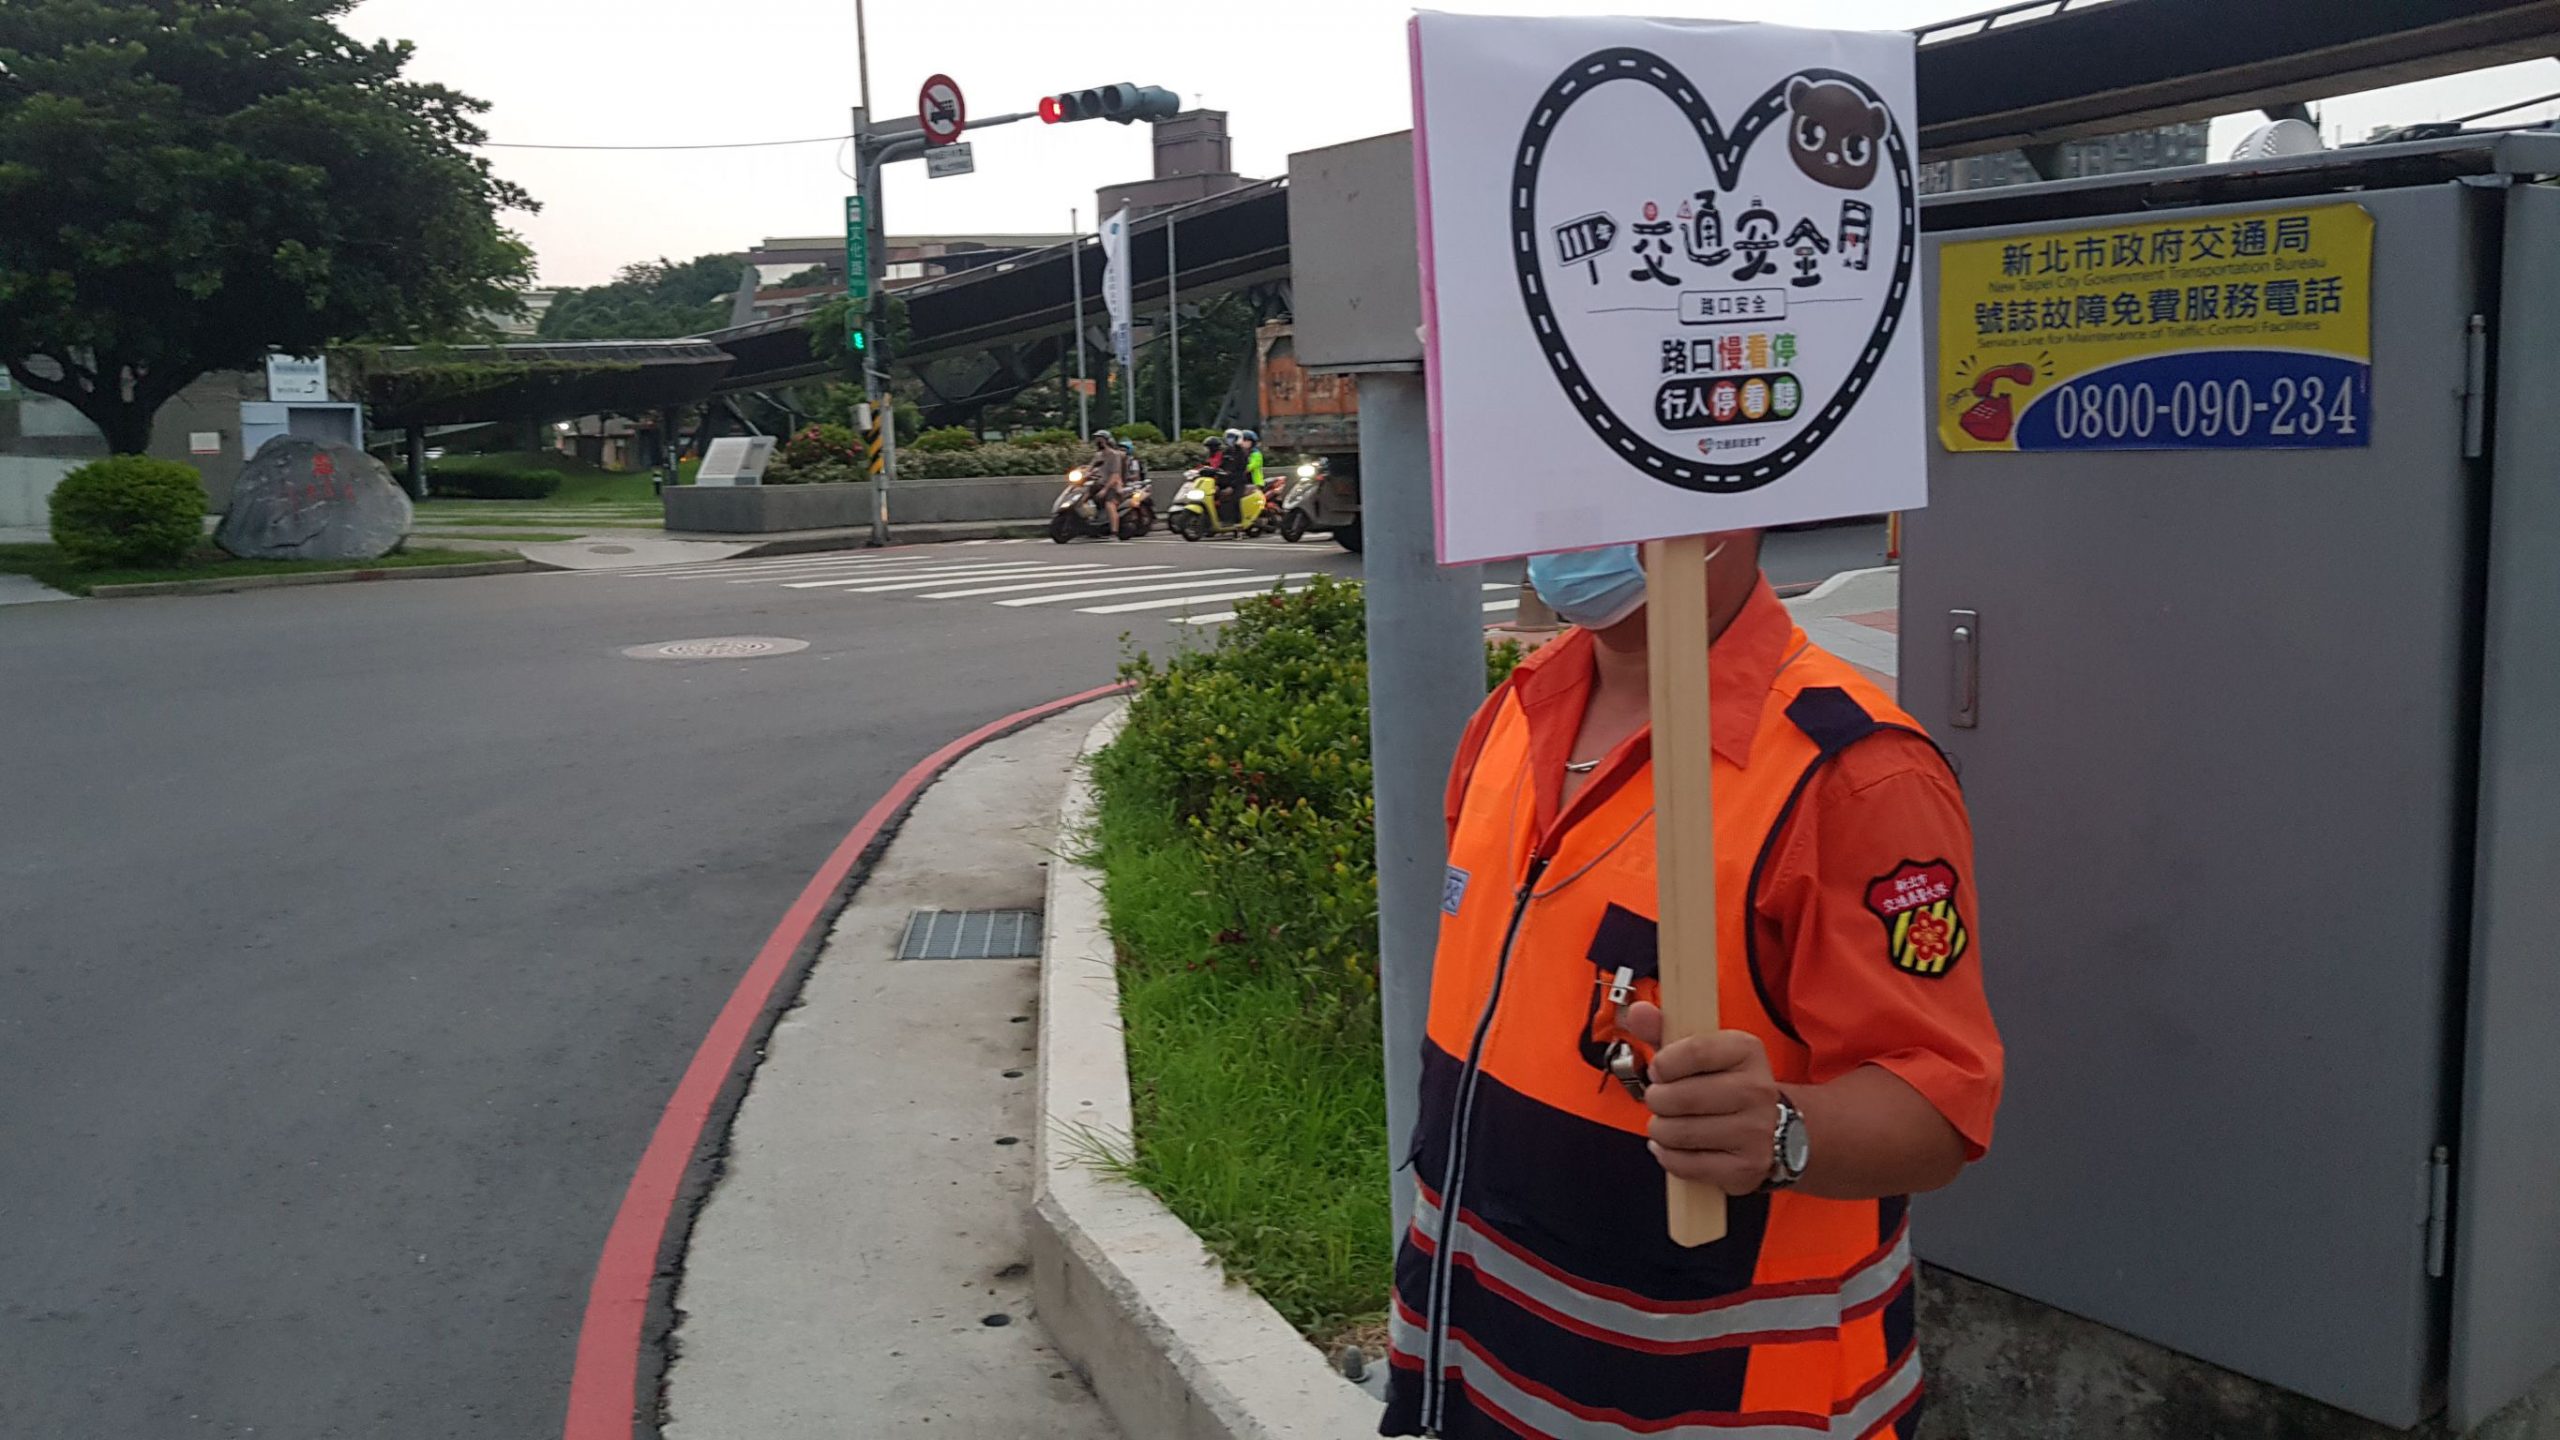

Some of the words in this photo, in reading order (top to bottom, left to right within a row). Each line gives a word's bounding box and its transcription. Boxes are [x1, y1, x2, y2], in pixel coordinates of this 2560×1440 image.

[2002, 215, 2311, 277] 新北市政府交通局
[1988, 281, 2016, 293] New
[2020, 278, 2053, 292] Taipei
[2057, 275, 2080, 290] City
[2083, 269, 2165, 287] Government
[2168, 262, 2270, 280] Transportation
[2273, 257, 2327, 272] Bureau
[1701, 295, 1766, 315] 路口安全
[1975, 275, 2344, 335] 號誌故障免費服務電話
[1661, 332, 1798, 374] 路口慢看停
[1977, 338, 2020, 348] Service
[2021, 335, 2044, 346] Line
[2048, 333, 2064, 344] for
[2067, 329, 2147, 343] Maintenance
[2149, 328, 2163, 338] of
[2168, 325, 2203, 337] Traffic
[2209, 323, 2256, 336] Control
[2261, 320, 2320, 332] Facilities
[1661, 382, 1798, 420] 行人停看聽
[2055, 376, 2357, 439] 0800-090-234
[1895, 874, 1928, 893] 新北市
